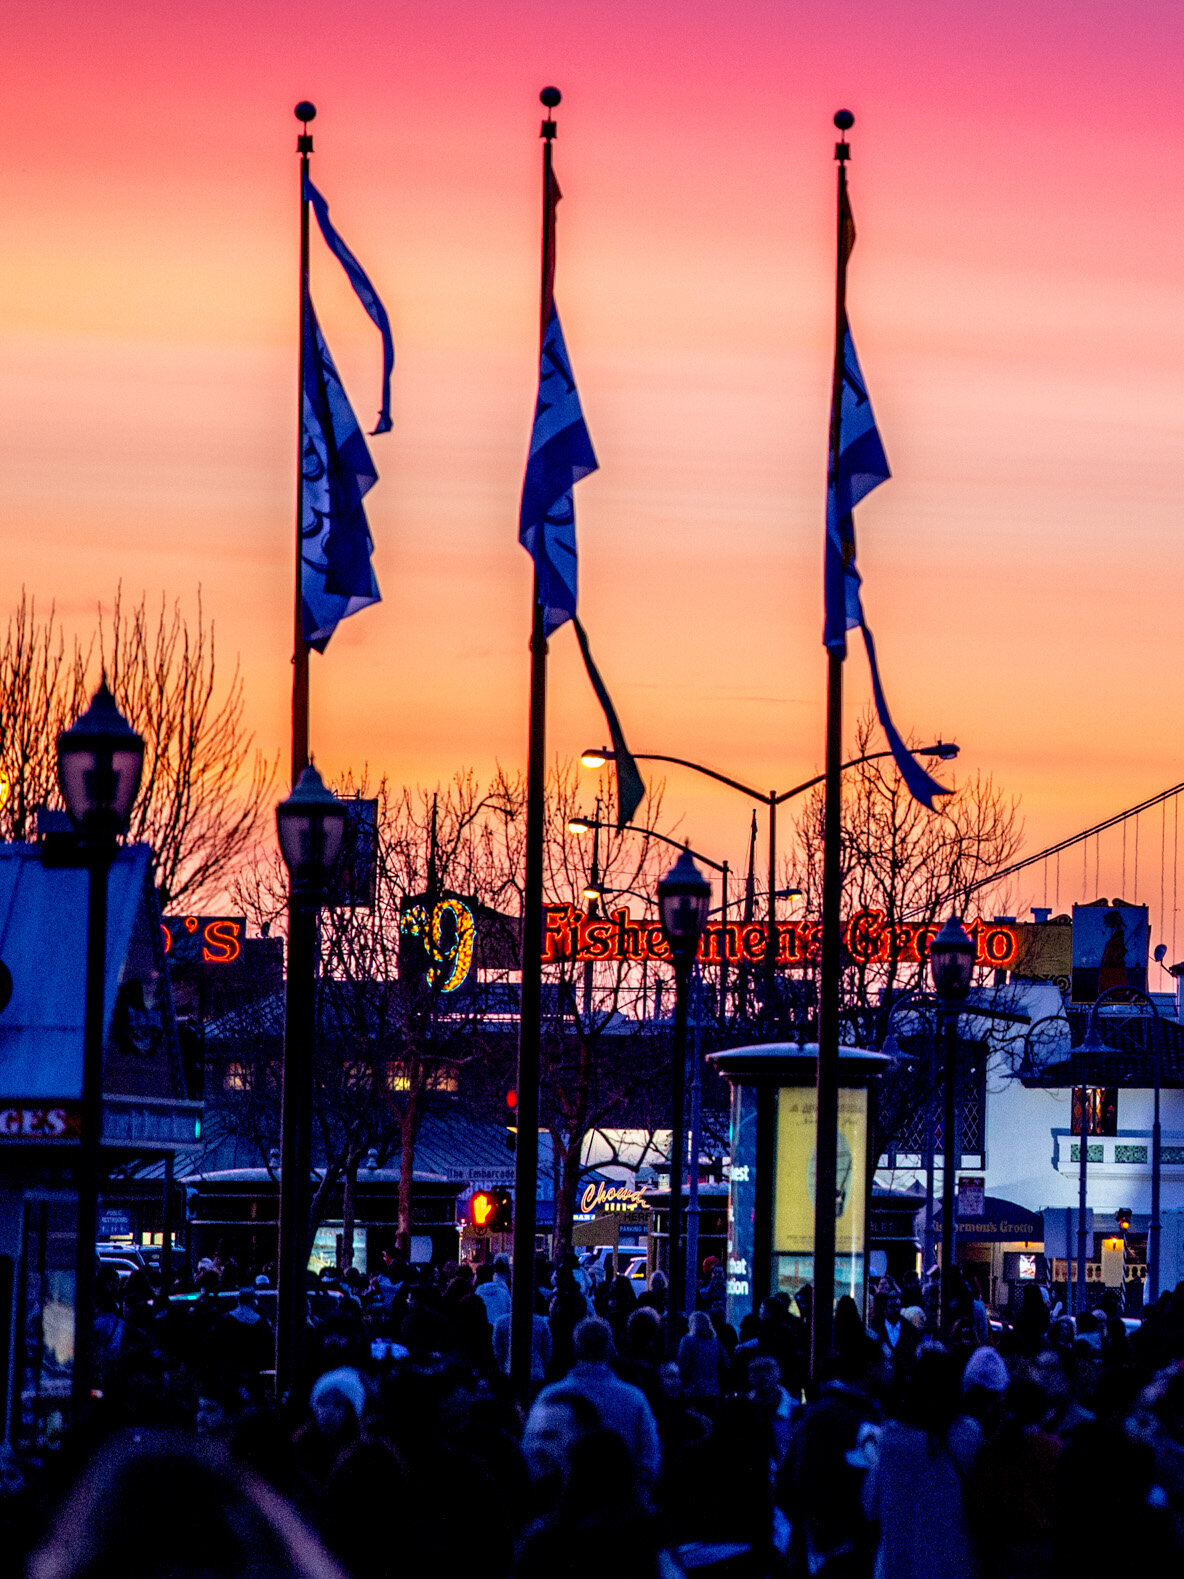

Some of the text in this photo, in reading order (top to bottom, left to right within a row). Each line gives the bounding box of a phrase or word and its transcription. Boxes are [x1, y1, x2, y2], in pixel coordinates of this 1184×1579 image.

[541, 903, 1016, 963] Fishemen's Groto
[999, 1220, 1034, 1233] Grotto
